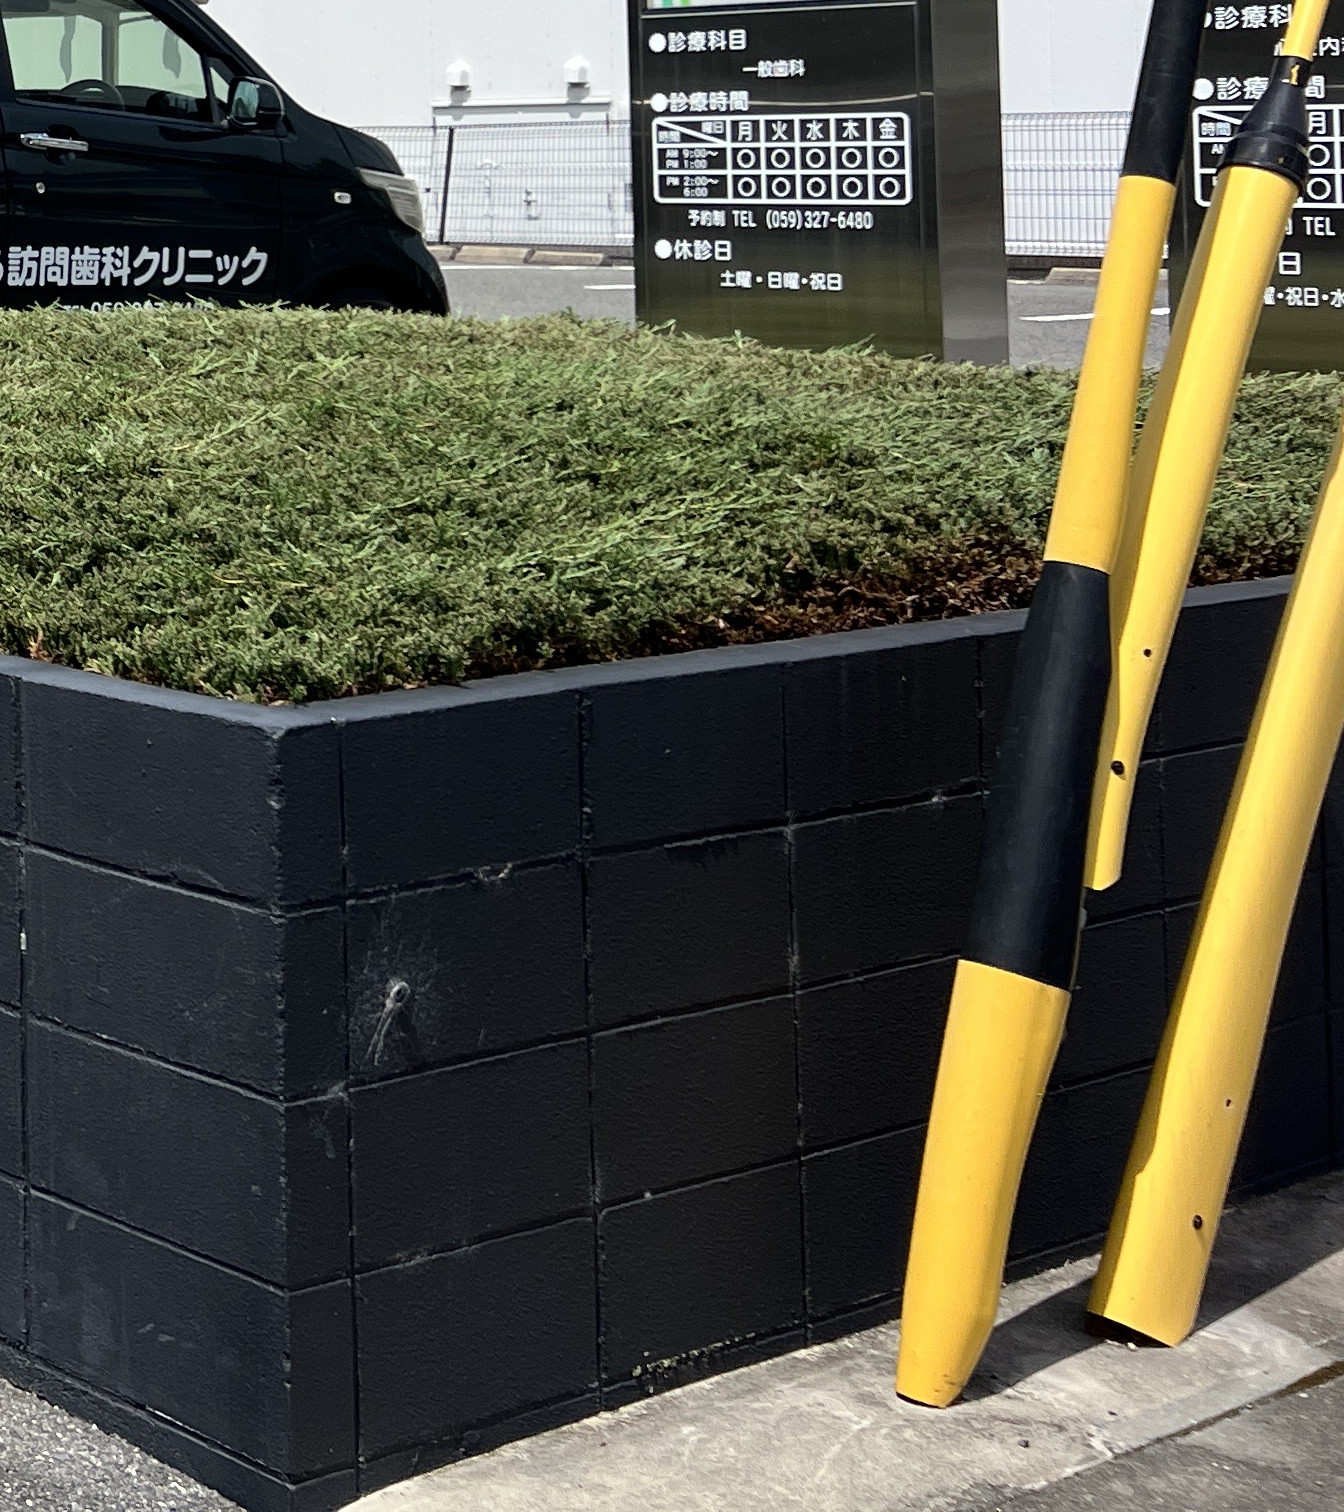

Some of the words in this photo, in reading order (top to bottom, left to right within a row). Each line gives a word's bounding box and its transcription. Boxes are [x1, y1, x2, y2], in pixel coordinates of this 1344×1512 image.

[667, 29, 747, 53] 診療科目
[1216, 75, 1326, 100] 診療間
[669, 90, 750, 113] 診療時間
[737, 121, 753, 142] 月
[771, 120, 788, 141] 火
[806, 119, 825, 140] 水
[841, 119, 861, 140] 木
[878, 117, 898, 140] 金
[732, 210, 757, 228] TEL
[1302, 216, 1336, 236] TEL
[673, 239, 733, 261] 休診日
